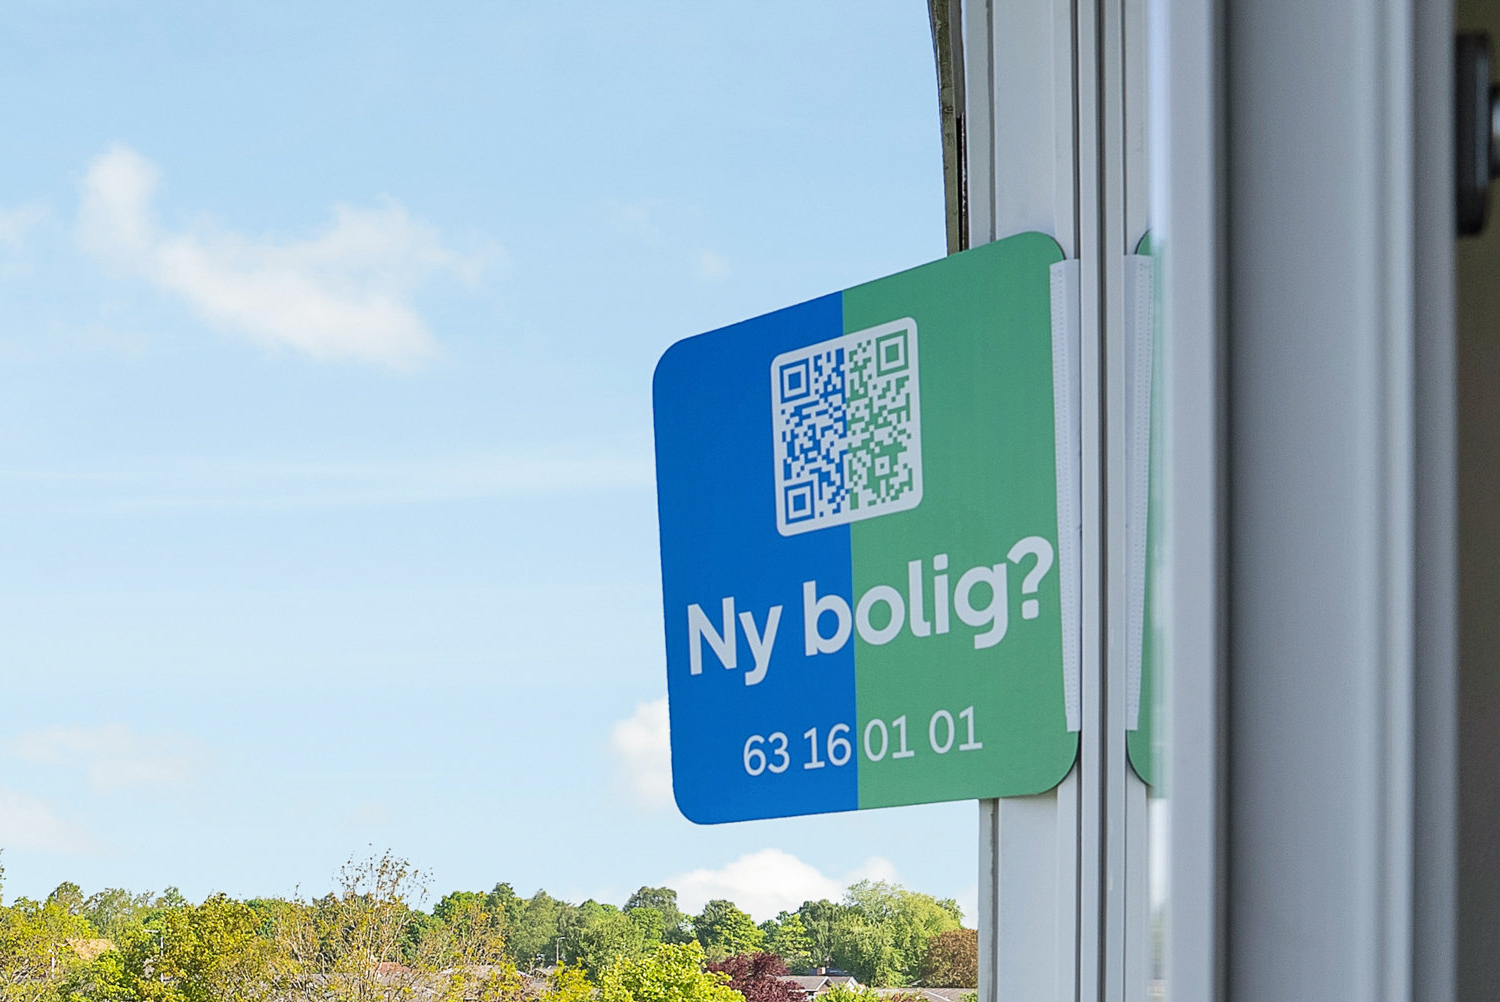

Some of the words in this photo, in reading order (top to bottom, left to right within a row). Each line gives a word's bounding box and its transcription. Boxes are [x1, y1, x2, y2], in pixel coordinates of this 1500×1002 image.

[687, 596, 783, 686] Ny
[803, 536, 1055, 656] bolig?
[743, 732, 790, 776] 63
[804, 723, 852, 769] 16
[863, 714, 915, 762] 01
[928, 705, 983, 755] 01
